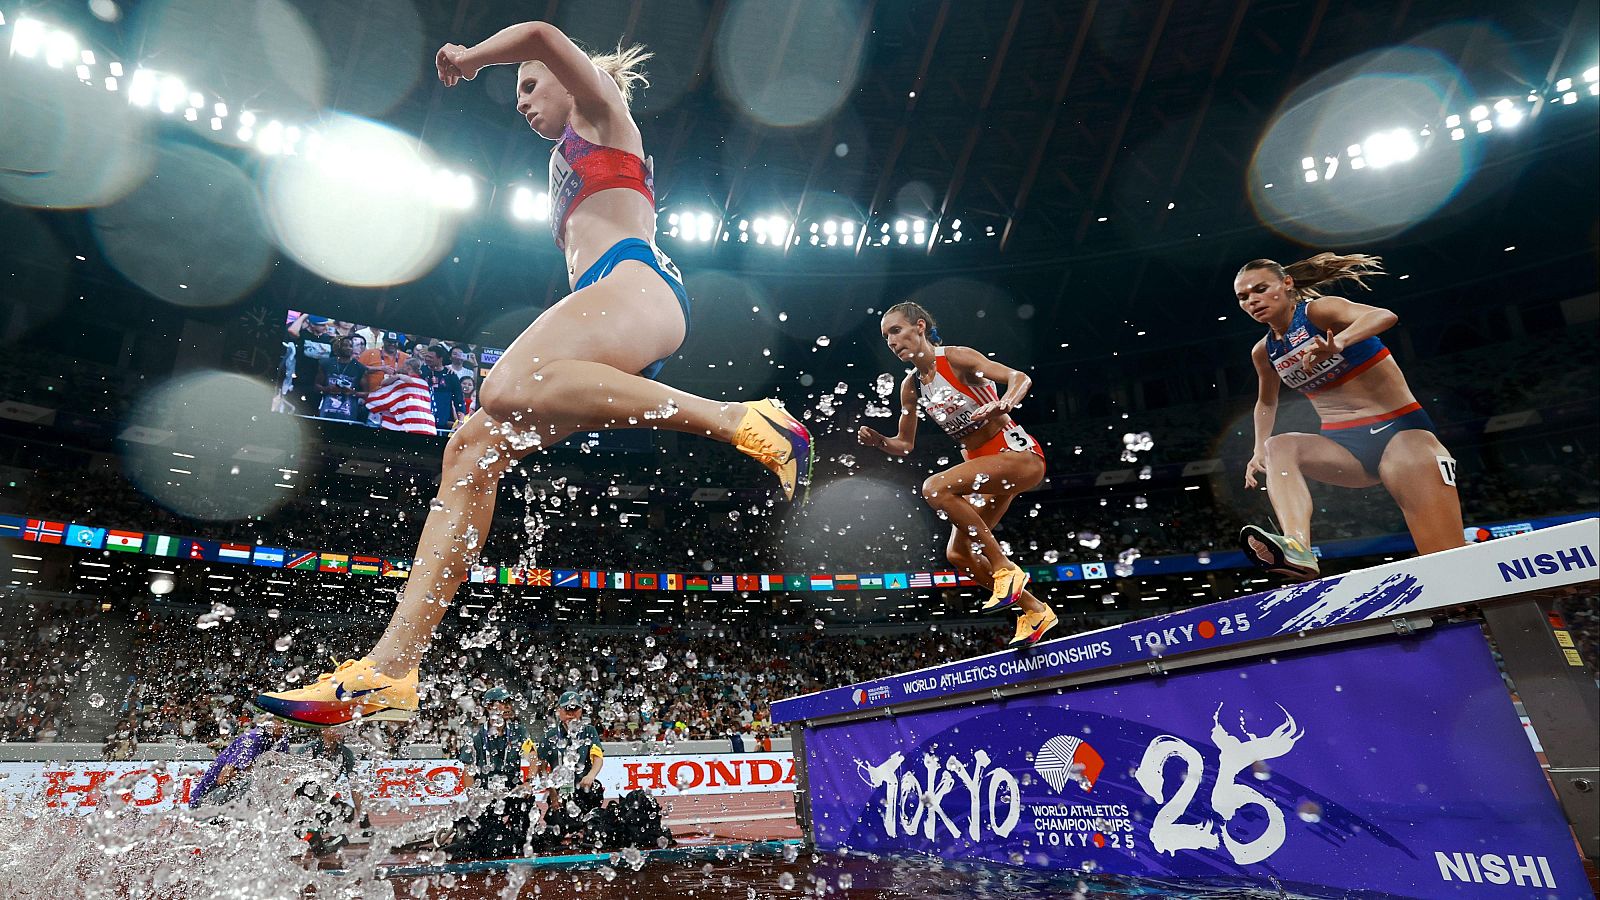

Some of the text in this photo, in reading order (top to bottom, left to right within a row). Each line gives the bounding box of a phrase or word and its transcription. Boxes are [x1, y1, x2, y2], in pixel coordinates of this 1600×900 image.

[1283, 356, 1339, 386] THONER
[1010, 432, 1028, 446] 3
[1440, 460, 1455, 482] 1
[1497, 545, 1598, 583] NISHI
[1217, 613, 1251, 637] 25
[903, 678, 938, 695] WORLD
[939, 664, 998, 688] ATHLETICS
[999, 640, 1113, 676] CHAMPIONSHIPS
[854, 749, 1021, 843] TOKYO
[1135, 701, 1305, 865] 25
[1031, 804, 1129, 817] WORLD ATHLETICS
[1110, 833, 1135, 849] 25
[1435, 851, 1557, 889] NISHI
